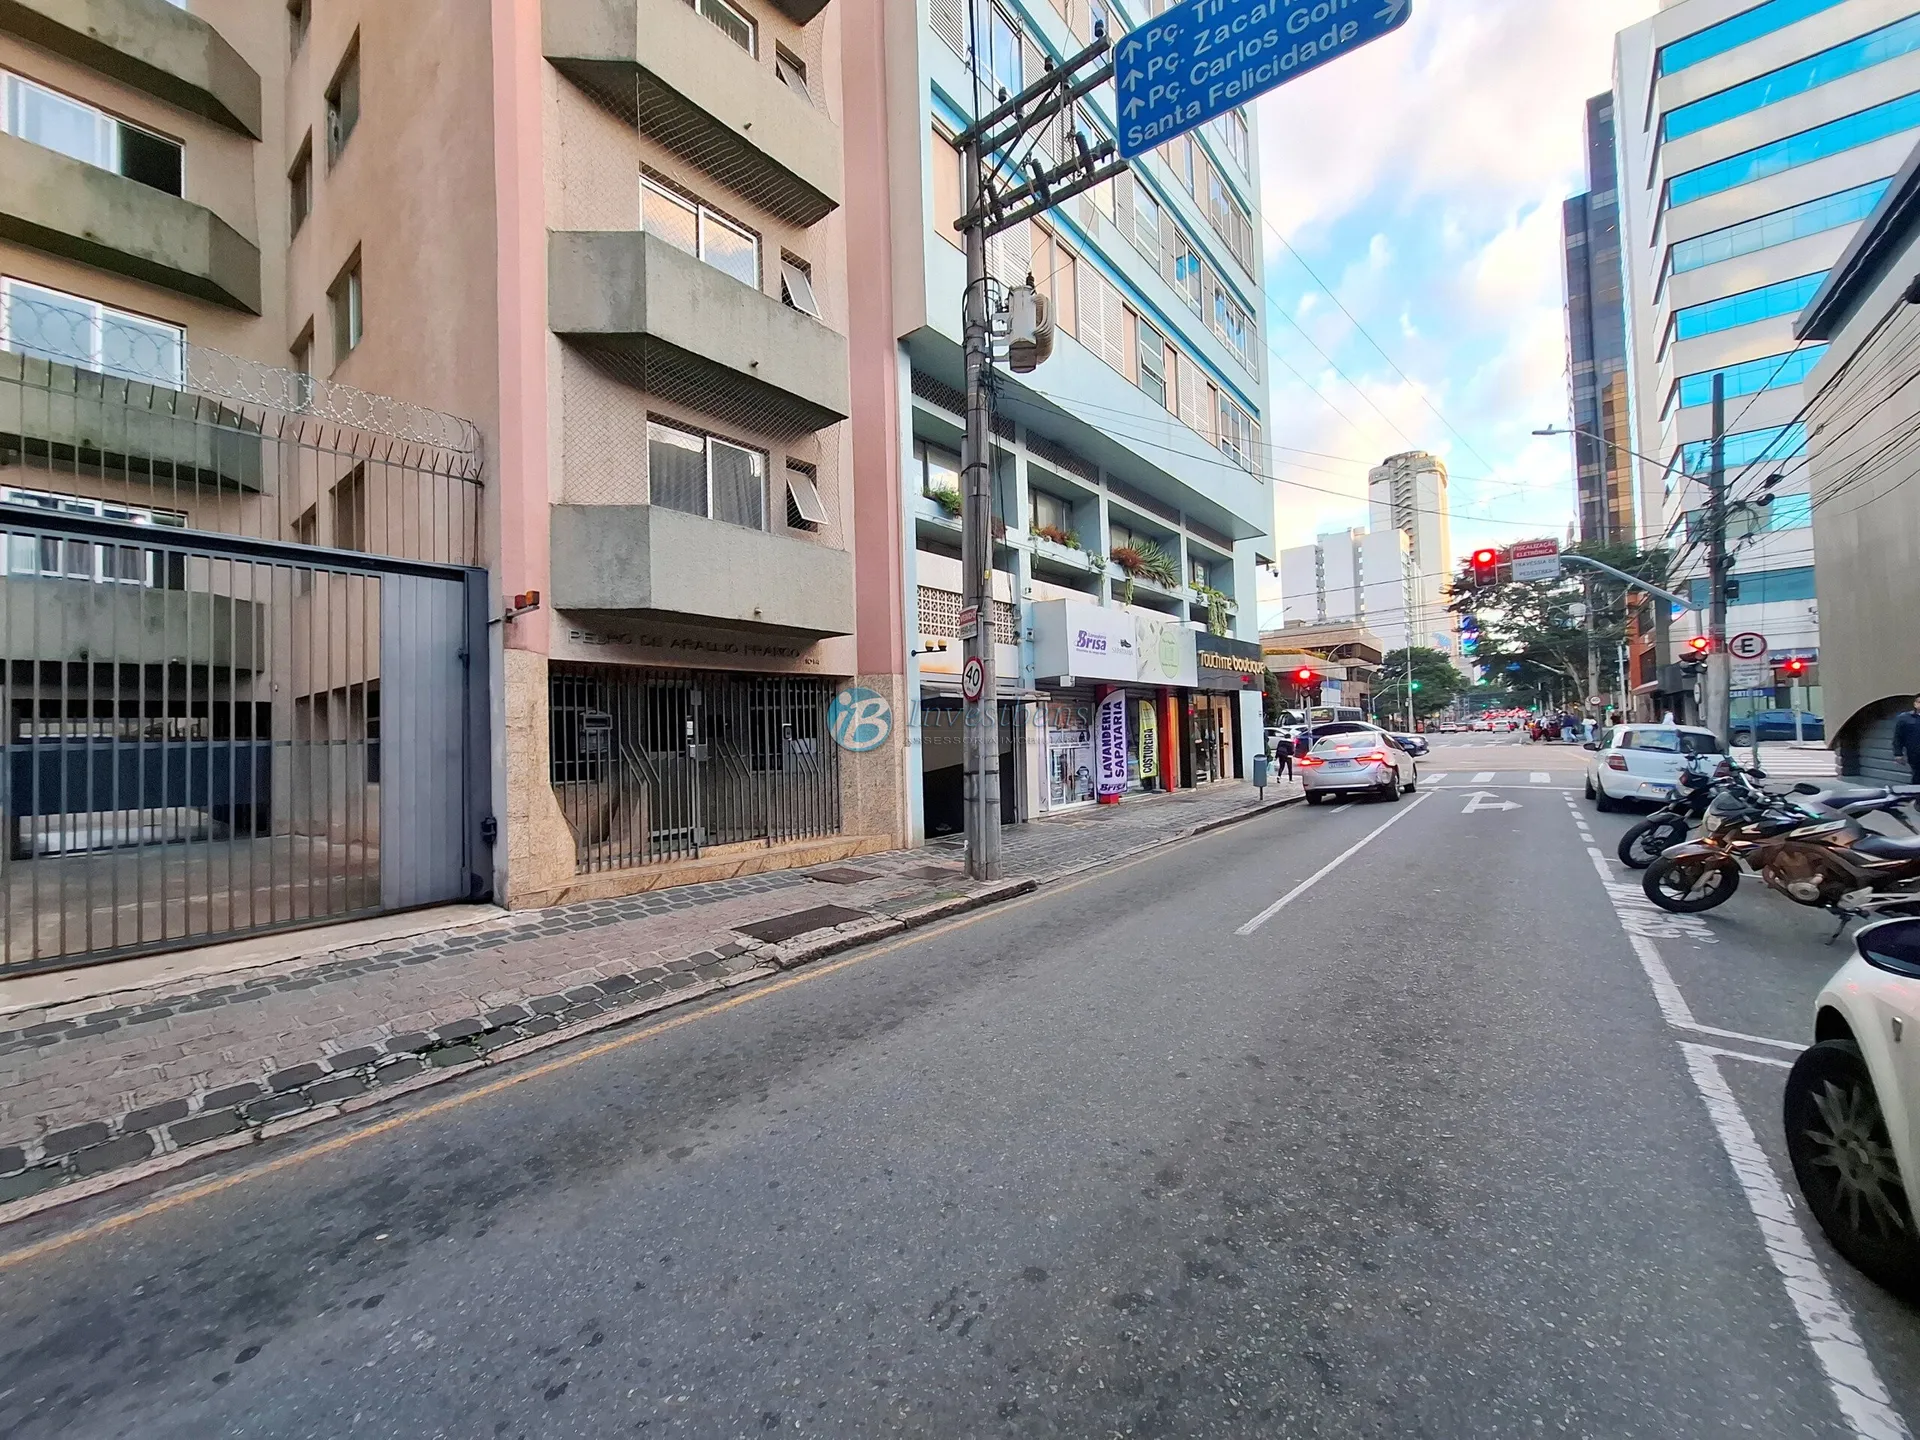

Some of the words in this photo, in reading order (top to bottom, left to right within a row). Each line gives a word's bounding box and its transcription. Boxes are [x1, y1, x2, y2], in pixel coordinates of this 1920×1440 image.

[1146, 23, 1185, 53] Pç.
[1127, 100, 1201, 147] Santa
[1208, 18, 1359, 108] Felicidade
[1147, 52, 1185, 81] Pç.
[1148, 81, 1186, 110] Pç.
[1189, 28, 1278, 86] Carlos
[1076, 629, 1107, 651] Brisa
[1740, 637, 1755, 654] E
[965, 665, 980, 687] 40
[1102, 702, 1113, 778] LAVANDERIA
[1113, 701, 1125, 778] SAPATARIA
[1143, 728, 1154, 774] COSTUREIRA
